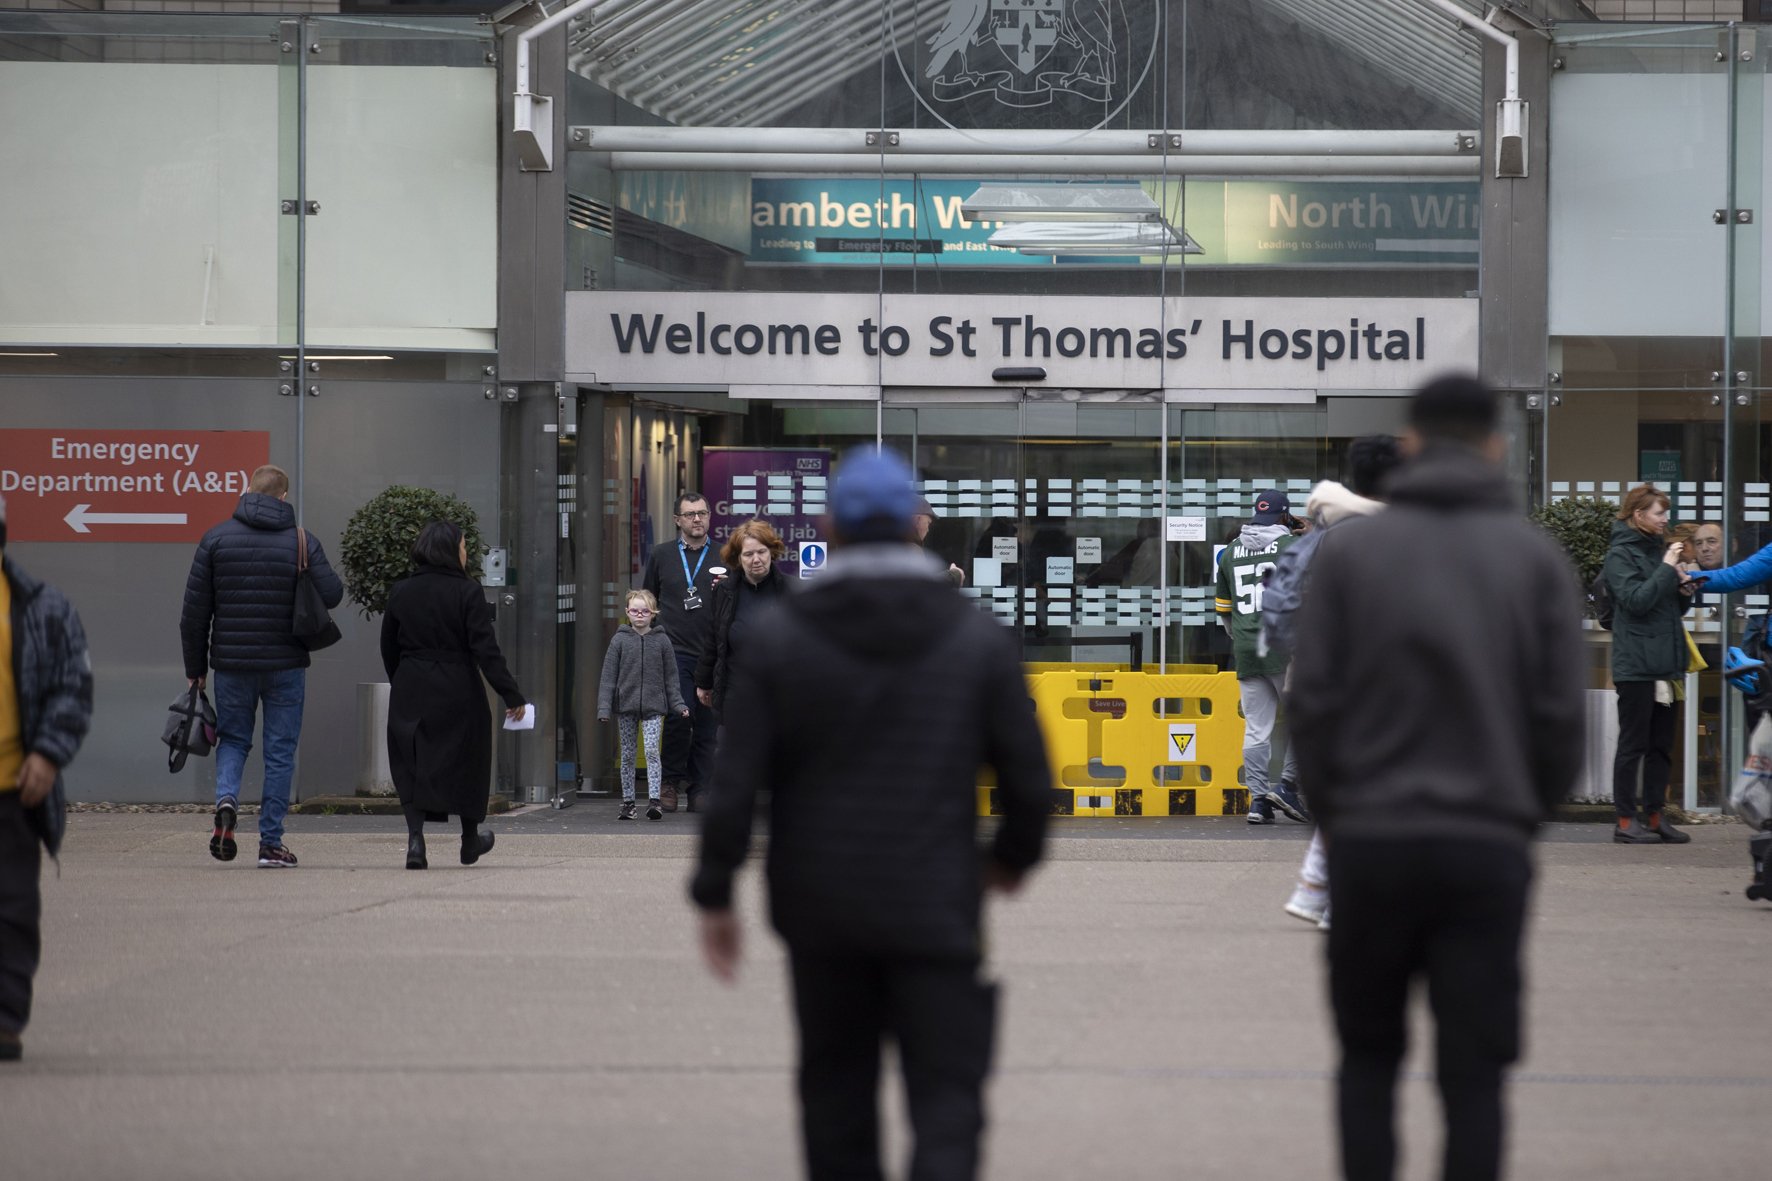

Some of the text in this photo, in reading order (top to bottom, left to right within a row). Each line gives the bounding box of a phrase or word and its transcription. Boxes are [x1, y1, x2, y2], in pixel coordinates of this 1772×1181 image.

[752, 192, 918, 228] ambeth
[1268, 193, 1479, 228] North Wi
[760, 237, 815, 251] Leading to
[838, 240, 893, 252] Emergency
[943, 241, 963, 251] and
[965, 241, 987, 251] East
[1258, 239, 1298, 251] Leading
[1301, 240, 1312, 249] to
[1314, 240, 1345, 249] South
[610, 312, 841, 355] Welcome
[858, 317, 910, 356] to
[929, 315, 977, 357] St
[1222, 317, 1425, 371] Hospital
[51, 438, 199, 466] Emergency
[798, 459, 821, 469] NHS
[1, 469, 248, 497] Department (A&E)
[788, 523, 817, 542] jab
